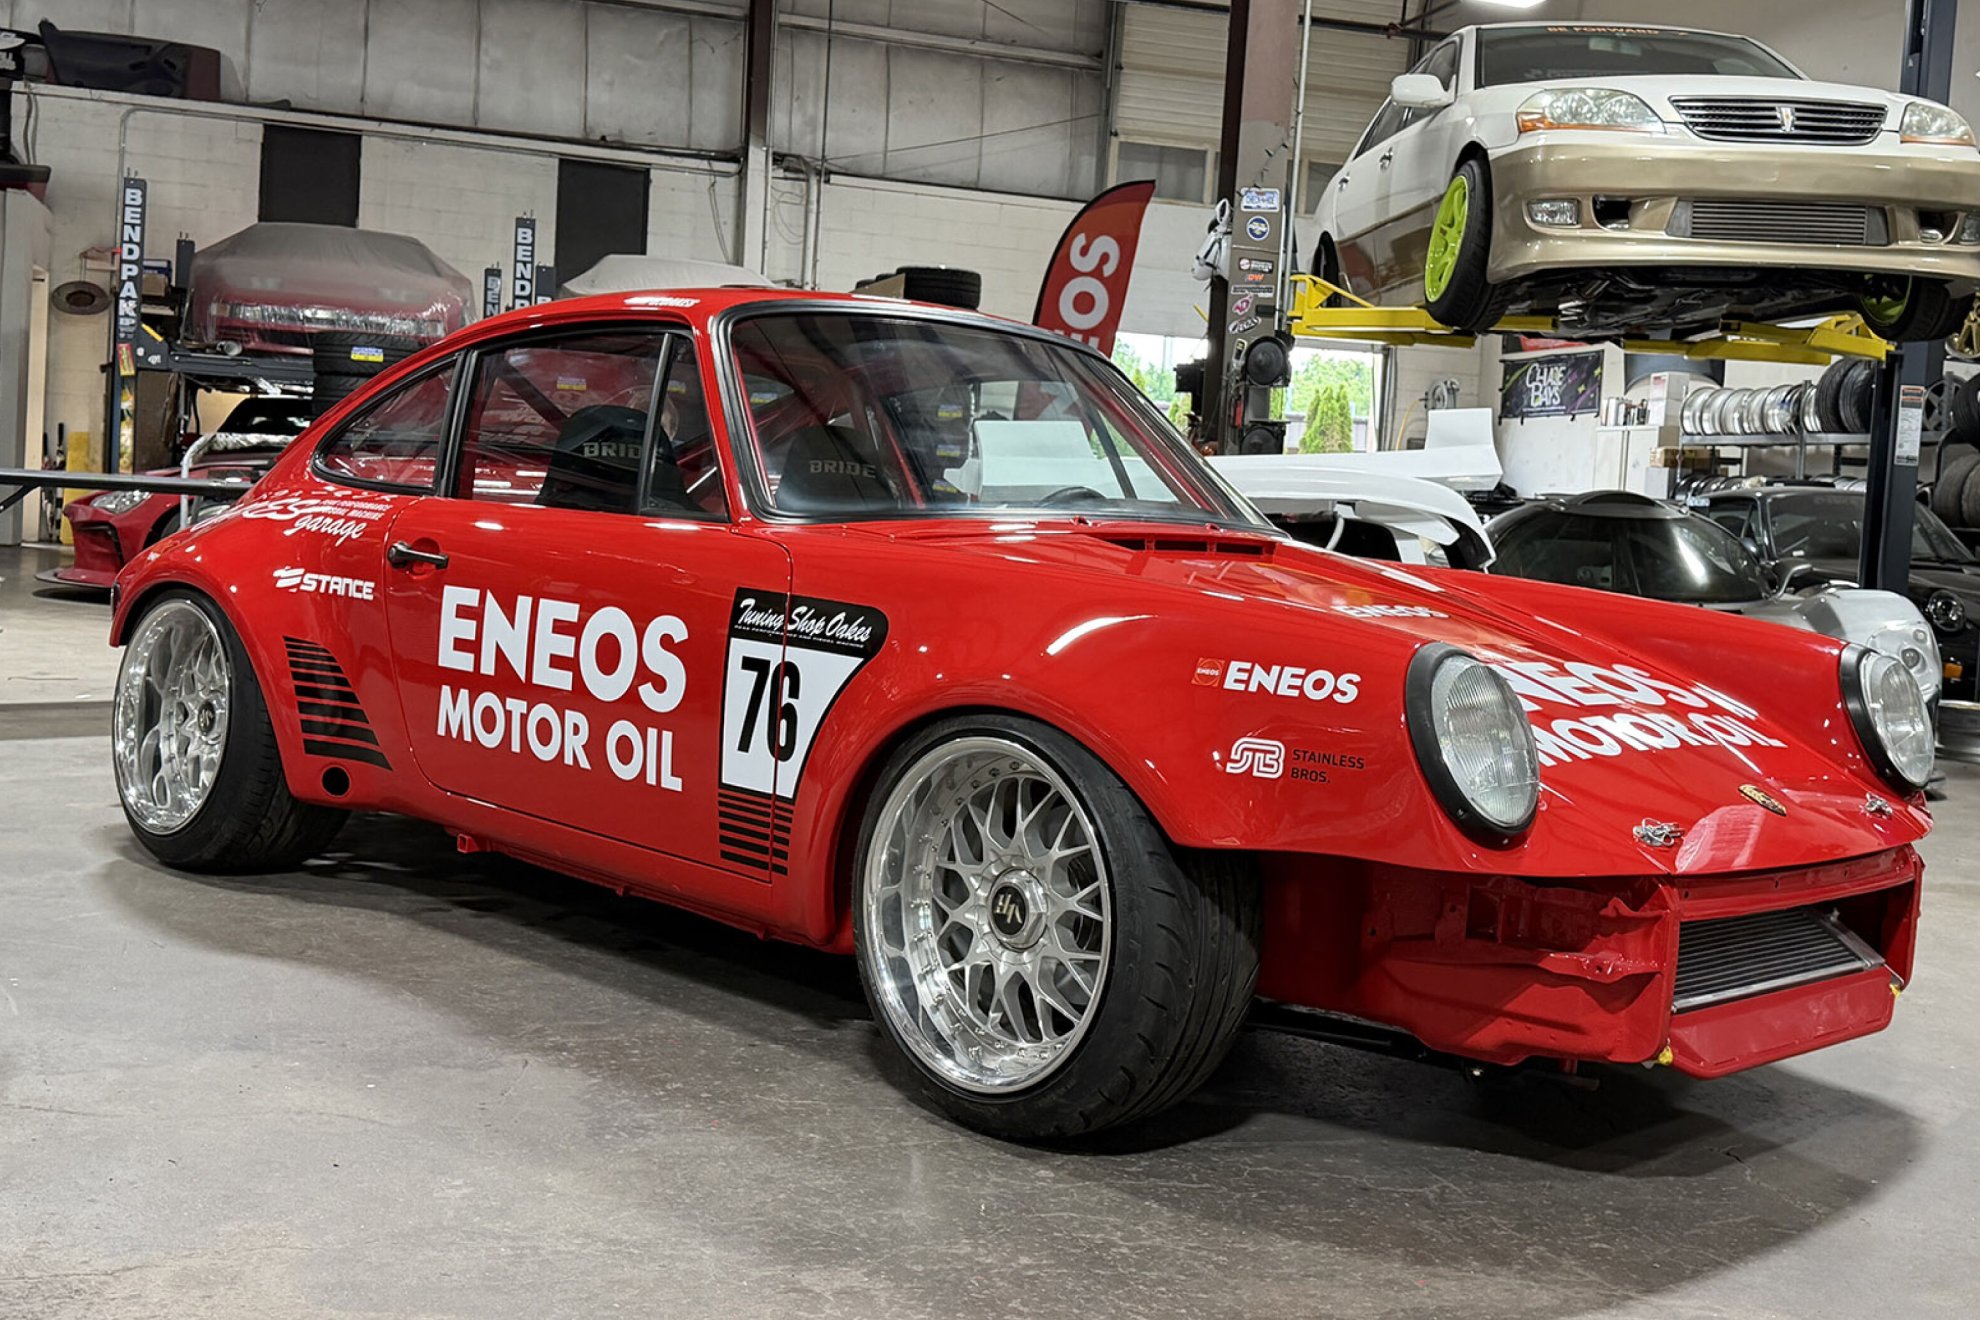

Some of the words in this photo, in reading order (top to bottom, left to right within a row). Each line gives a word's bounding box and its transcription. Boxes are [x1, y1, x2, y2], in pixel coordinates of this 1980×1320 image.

[1572, 26, 1660, 36] FORWARD
[809, 460, 877, 479] BRIDE
[283, 515, 368, 547] garage
[299, 573, 375, 600] STANCE
[738, 598, 785, 631] Tuning
[787, 606, 826, 636] Shop
[825, 612, 872, 642] Oakes
[438, 584, 689, 713] ENEOS
[1223, 661, 1362, 704] ENEOS
[737, 655, 801, 762] 76
[437, 685, 592, 770] MOTOR
[606, 720, 683, 792] OIL
[1531, 713, 1719, 767] MOTOR
[1687, 713, 1788, 748] OIL
[1291, 767, 1331, 783] BROS.
[1292, 749, 1366, 769] STAINLESS
